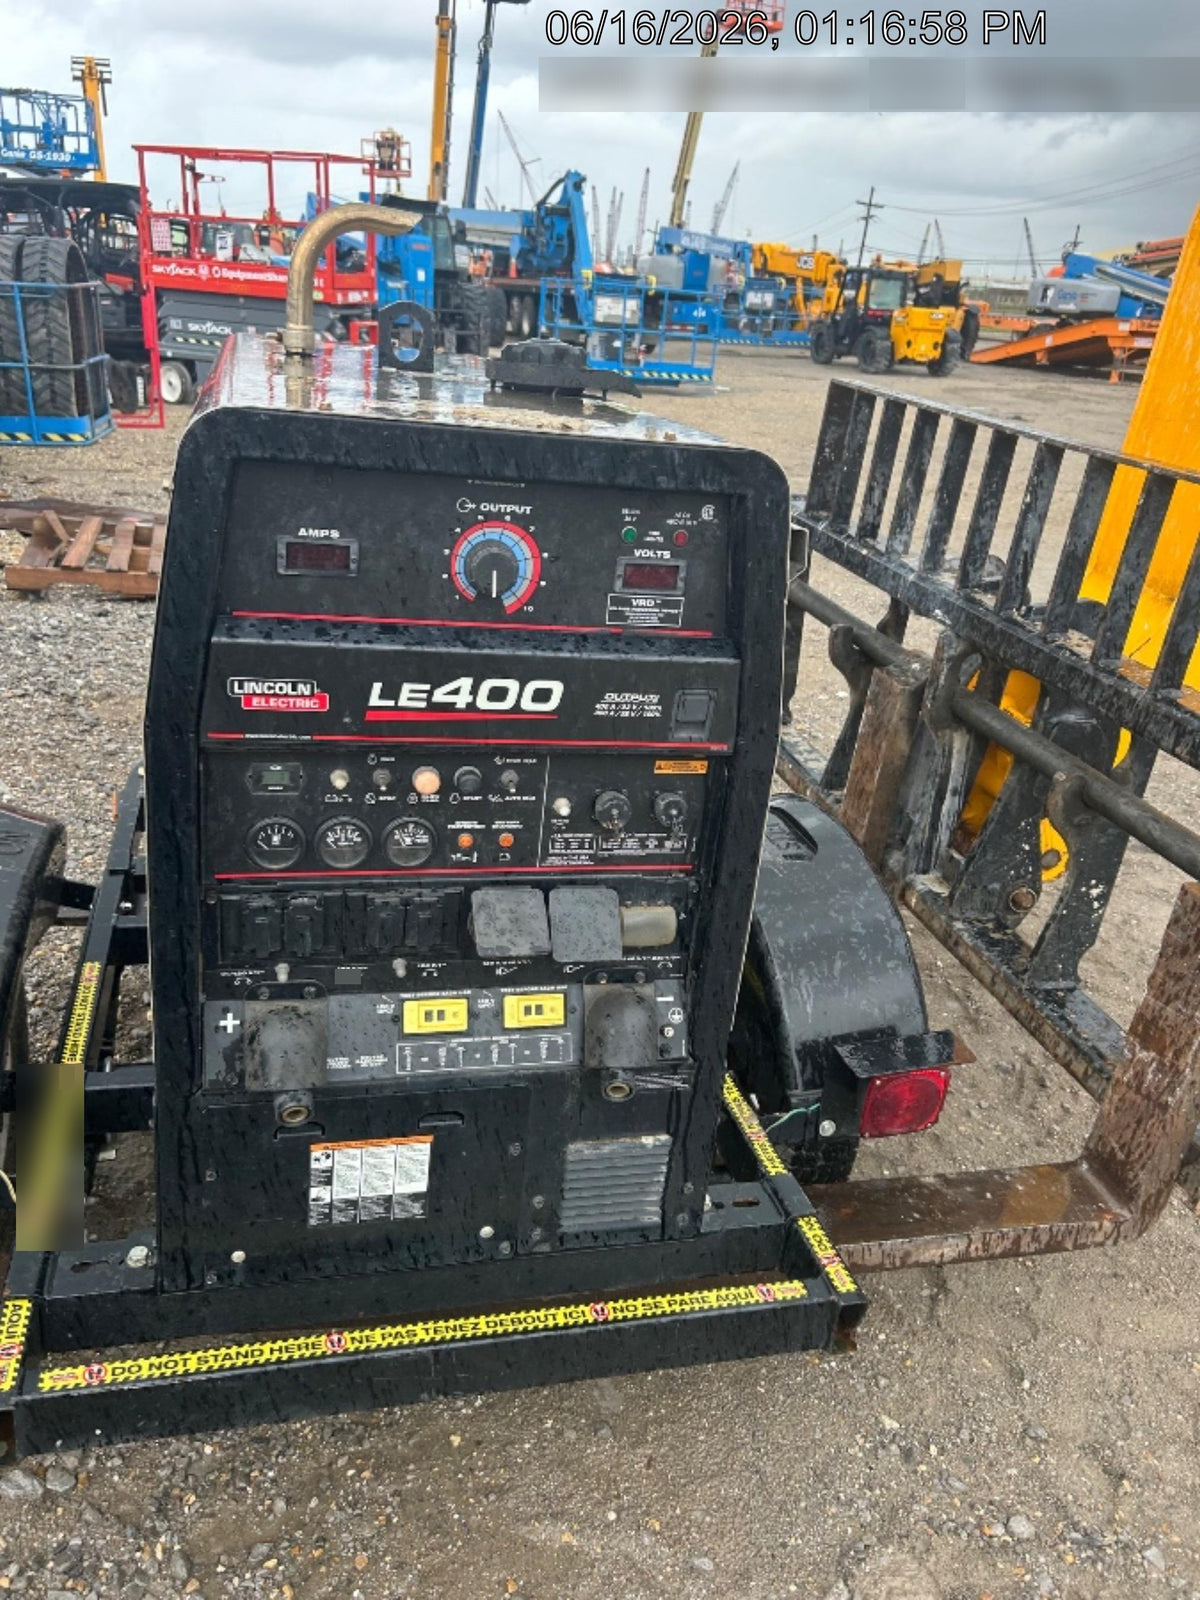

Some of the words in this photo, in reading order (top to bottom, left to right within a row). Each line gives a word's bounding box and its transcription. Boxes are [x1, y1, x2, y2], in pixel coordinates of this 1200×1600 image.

[151, 262, 196, 277] SKYJACK
[795, 255, 816, 270] JCB
[187, 320, 232, 335] SKYJACK
[480, 502, 534, 515] OUTPUT
[298, 527, 341, 539] AMPS
[633, 548, 671, 559] VOLTS
[233, 679, 311, 696] LINCOLN
[368, 676, 564, 712] LE400
[251, 697, 320, 709] ELECTRIC
[613, 1302, 639, 1316] NO
[643, 1300, 666, 1313] SE
[667, 1294, 713, 1310] PARE
[350, 1333, 376, 1346] NE
[380, 1328, 418, 1343] PAS
[421, 1320, 482, 1337] TENEZ
[486, 1313, 557, 1330] DEBOUT
[561, 1310, 588, 1322] ICI
[111, 1361, 141, 1377] DO
[148, 1356, 190, 1373] NOT
[196, 1348, 264, 1368] STAND
[269, 1340, 323, 1357] HERE
